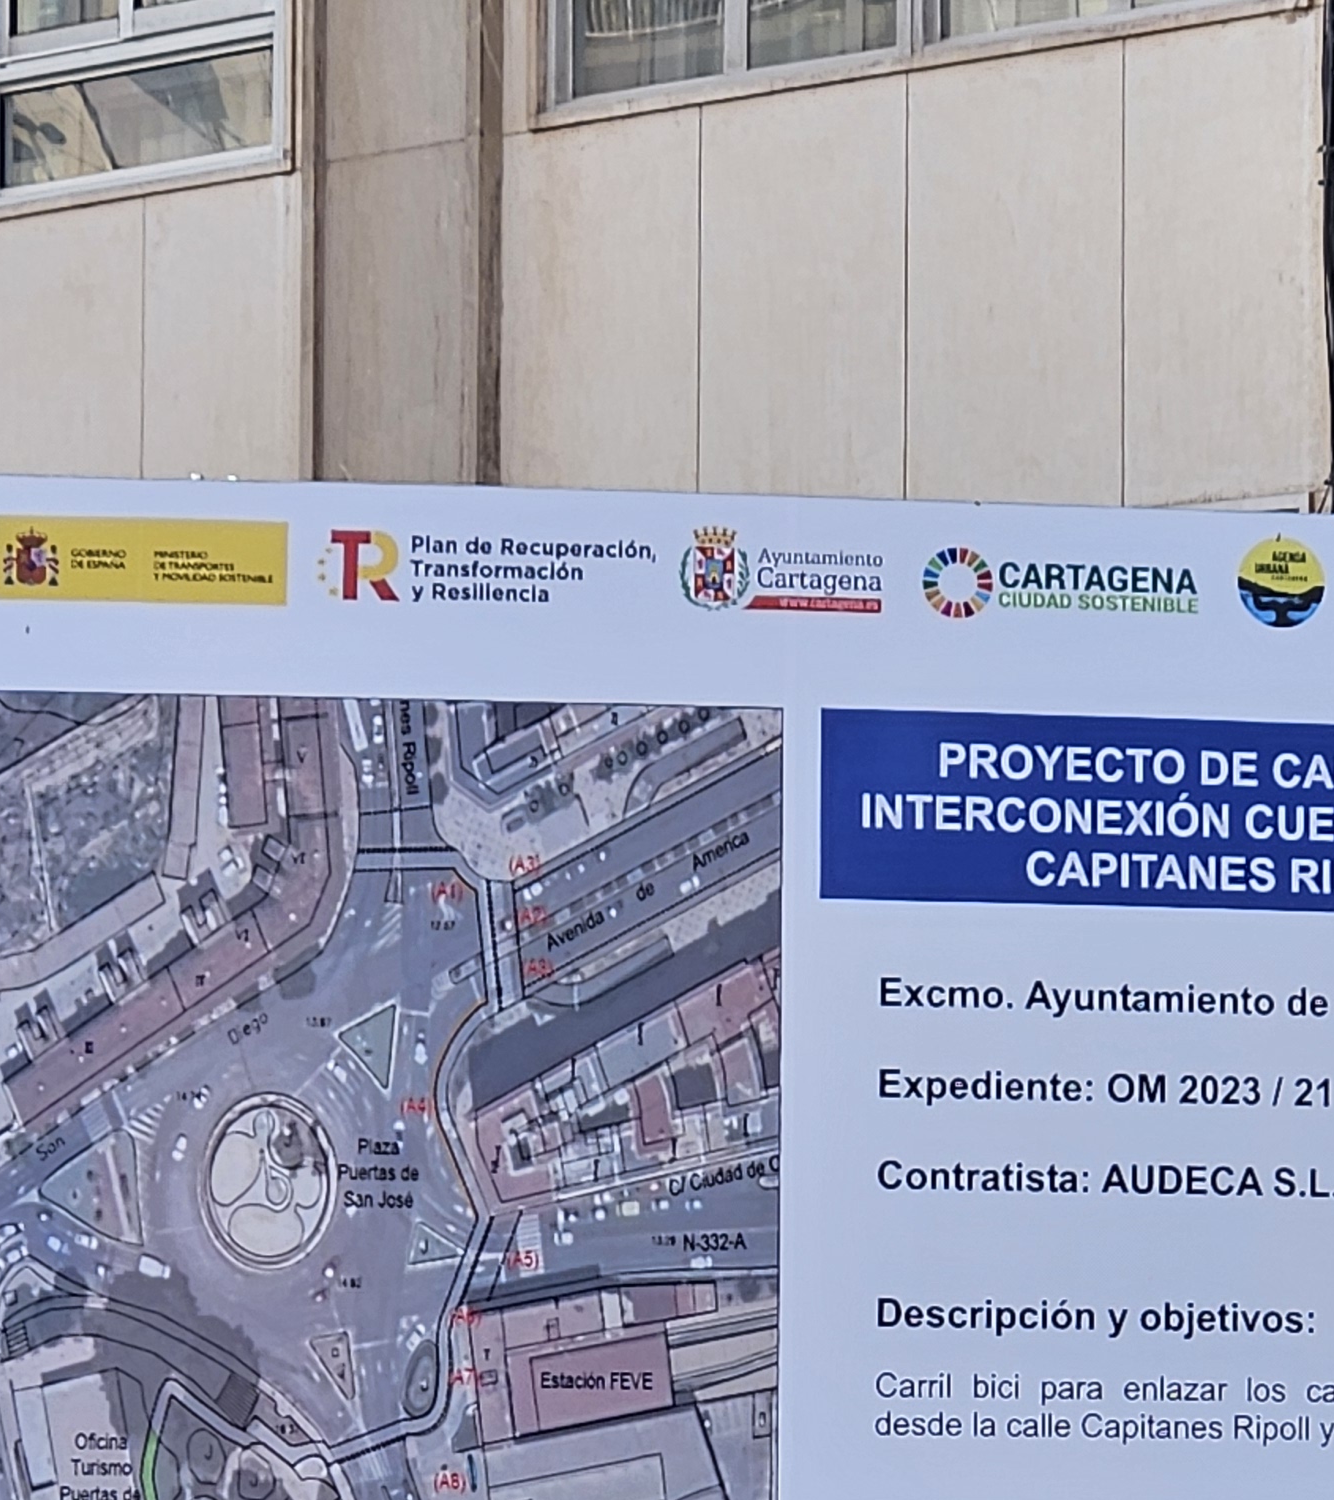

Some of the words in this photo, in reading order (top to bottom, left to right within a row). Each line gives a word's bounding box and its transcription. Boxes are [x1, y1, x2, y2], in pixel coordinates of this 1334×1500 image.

[411, 535, 457, 555] Plan
[465, 536, 492, 555] de
[500, 537, 657, 563] Recuperación,
[757, 547, 883, 573] Ayuntamiento
[409, 559, 584, 581] Transformación
[757, 566, 882, 596] Cartagena
[998, 561, 1198, 600] CARTAGENA
[411, 585, 424, 603] y
[432, 582, 549, 603] Resiliencia
[999, 591, 1071, 609] CIUDAD
[1078, 593, 1199, 614] SOSTENIBLE
[939, 742, 1186, 785] PROYECTO
[1200, 750, 1259, 787] DE
[861, 792, 1230, 839] INTERCONEXIÓN
[1026, 850, 1276, 893] CAPITANES
[546, 910, 605, 952] Avenida
[636, 881, 655, 901] de
[880, 977, 1013, 1009] Excmo.
[1025, 980, 1275, 1018] Ayuntamiento
[1287, 986, 1328, 1017] de
[227, 1012, 269, 1046] Diego
[879, 1068, 1093, 1107] Expediente:
[1107, 1073, 1166, 1104] OM
[1179, 1075, 1261, 1106] 2023
[1272, 1076, 1284, 1107] /
[1294, 1078, 1330, 1108] 21
[358, 1138, 400, 1155] Plaza
[338, 1164, 396, 1181] Puertas
[400, 1164, 419, 1181] de
[689, 1162, 743, 1191] Ciudad
[747, 1161, 765, 1178] de
[877, 1160, 1089, 1193] Contratista:
[1101, 1163, 1264, 1196] AUDECA
[344, 1190, 373, 1208] San
[377, 1190, 414, 1208] José
[683, 1232, 747, 1252] N-332-A
[877, 1297, 1095, 1337] Descripción
[1108, 1308, 1128, 1339] y
[1140, 1302, 1314, 1340] objetivos:
[541, 1371, 605, 1388] Estación
[610, 1372, 653, 1390] FEVE
[875, 1371, 951, 1399] Carril
[973, 1373, 1019, 1400] bici
[1041, 1381, 1103, 1406] para
[1123, 1375, 1228, 1402] enlazar
[1247, 1376, 1286, 1403] los
[75, 1432, 128, 1450] Oficina
[874, 1410, 962, 1437] desde
[973, 1411, 996, 1438] la
[1006, 1412, 1071, 1438] calle
[1081, 1412, 1223, 1446] Capitanes
[1234, 1414, 1310, 1447] Ripoll
[71, 1458, 133, 1476] Turismo
